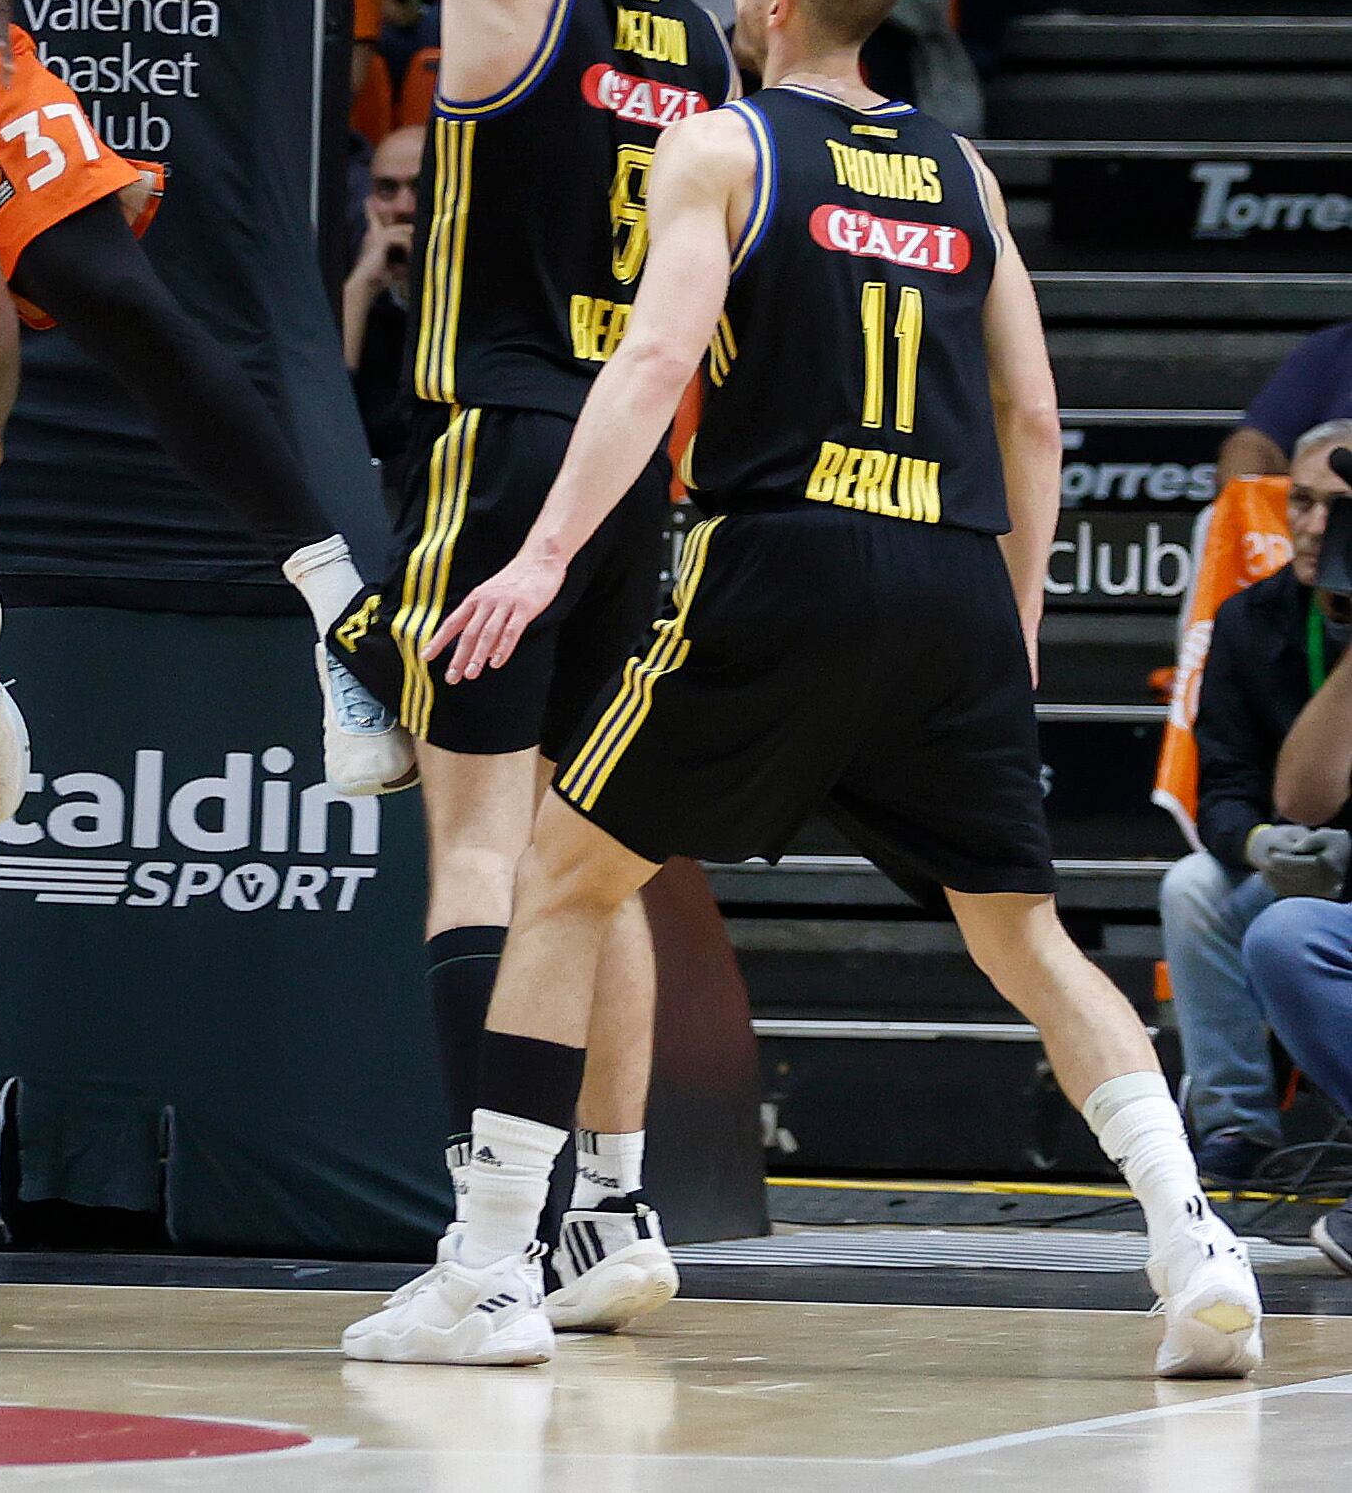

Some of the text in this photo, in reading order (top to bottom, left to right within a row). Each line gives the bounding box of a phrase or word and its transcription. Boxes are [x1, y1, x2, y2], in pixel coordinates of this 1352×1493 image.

[37, 41, 200, 98] basket
[0, 103, 101, 193] 37
[92, 99, 173, 152] lub
[825, 139, 943, 205] THOMAS
[1190, 161, 1352, 241] Torre
[860, 281, 923, 434] 11
[804, 440, 941, 525] BERLIN
[1063, 429, 1218, 506] orres
[1044, 520, 1192, 597] club
[125, 860, 378, 913] SPORT
